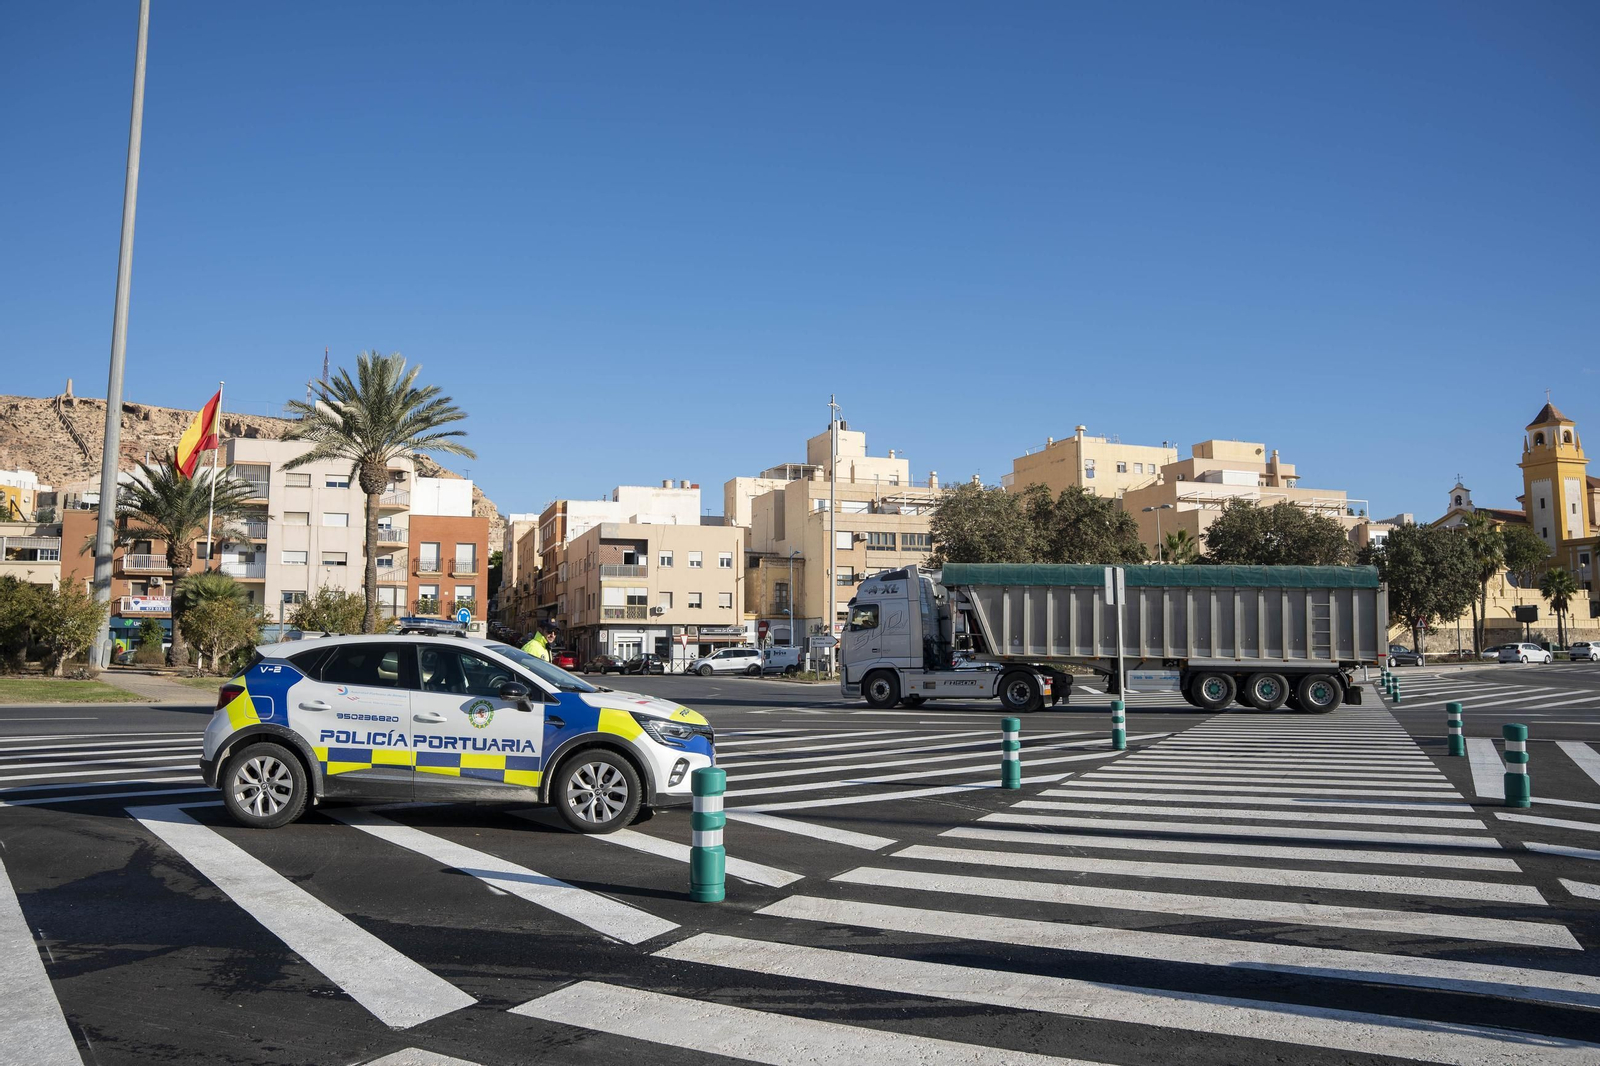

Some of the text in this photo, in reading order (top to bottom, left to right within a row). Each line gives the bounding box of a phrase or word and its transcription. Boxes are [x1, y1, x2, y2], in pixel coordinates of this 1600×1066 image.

[336, 713, 399, 722] 950236820
[319, 729, 535, 753] POLICÍA PORTUARIA
